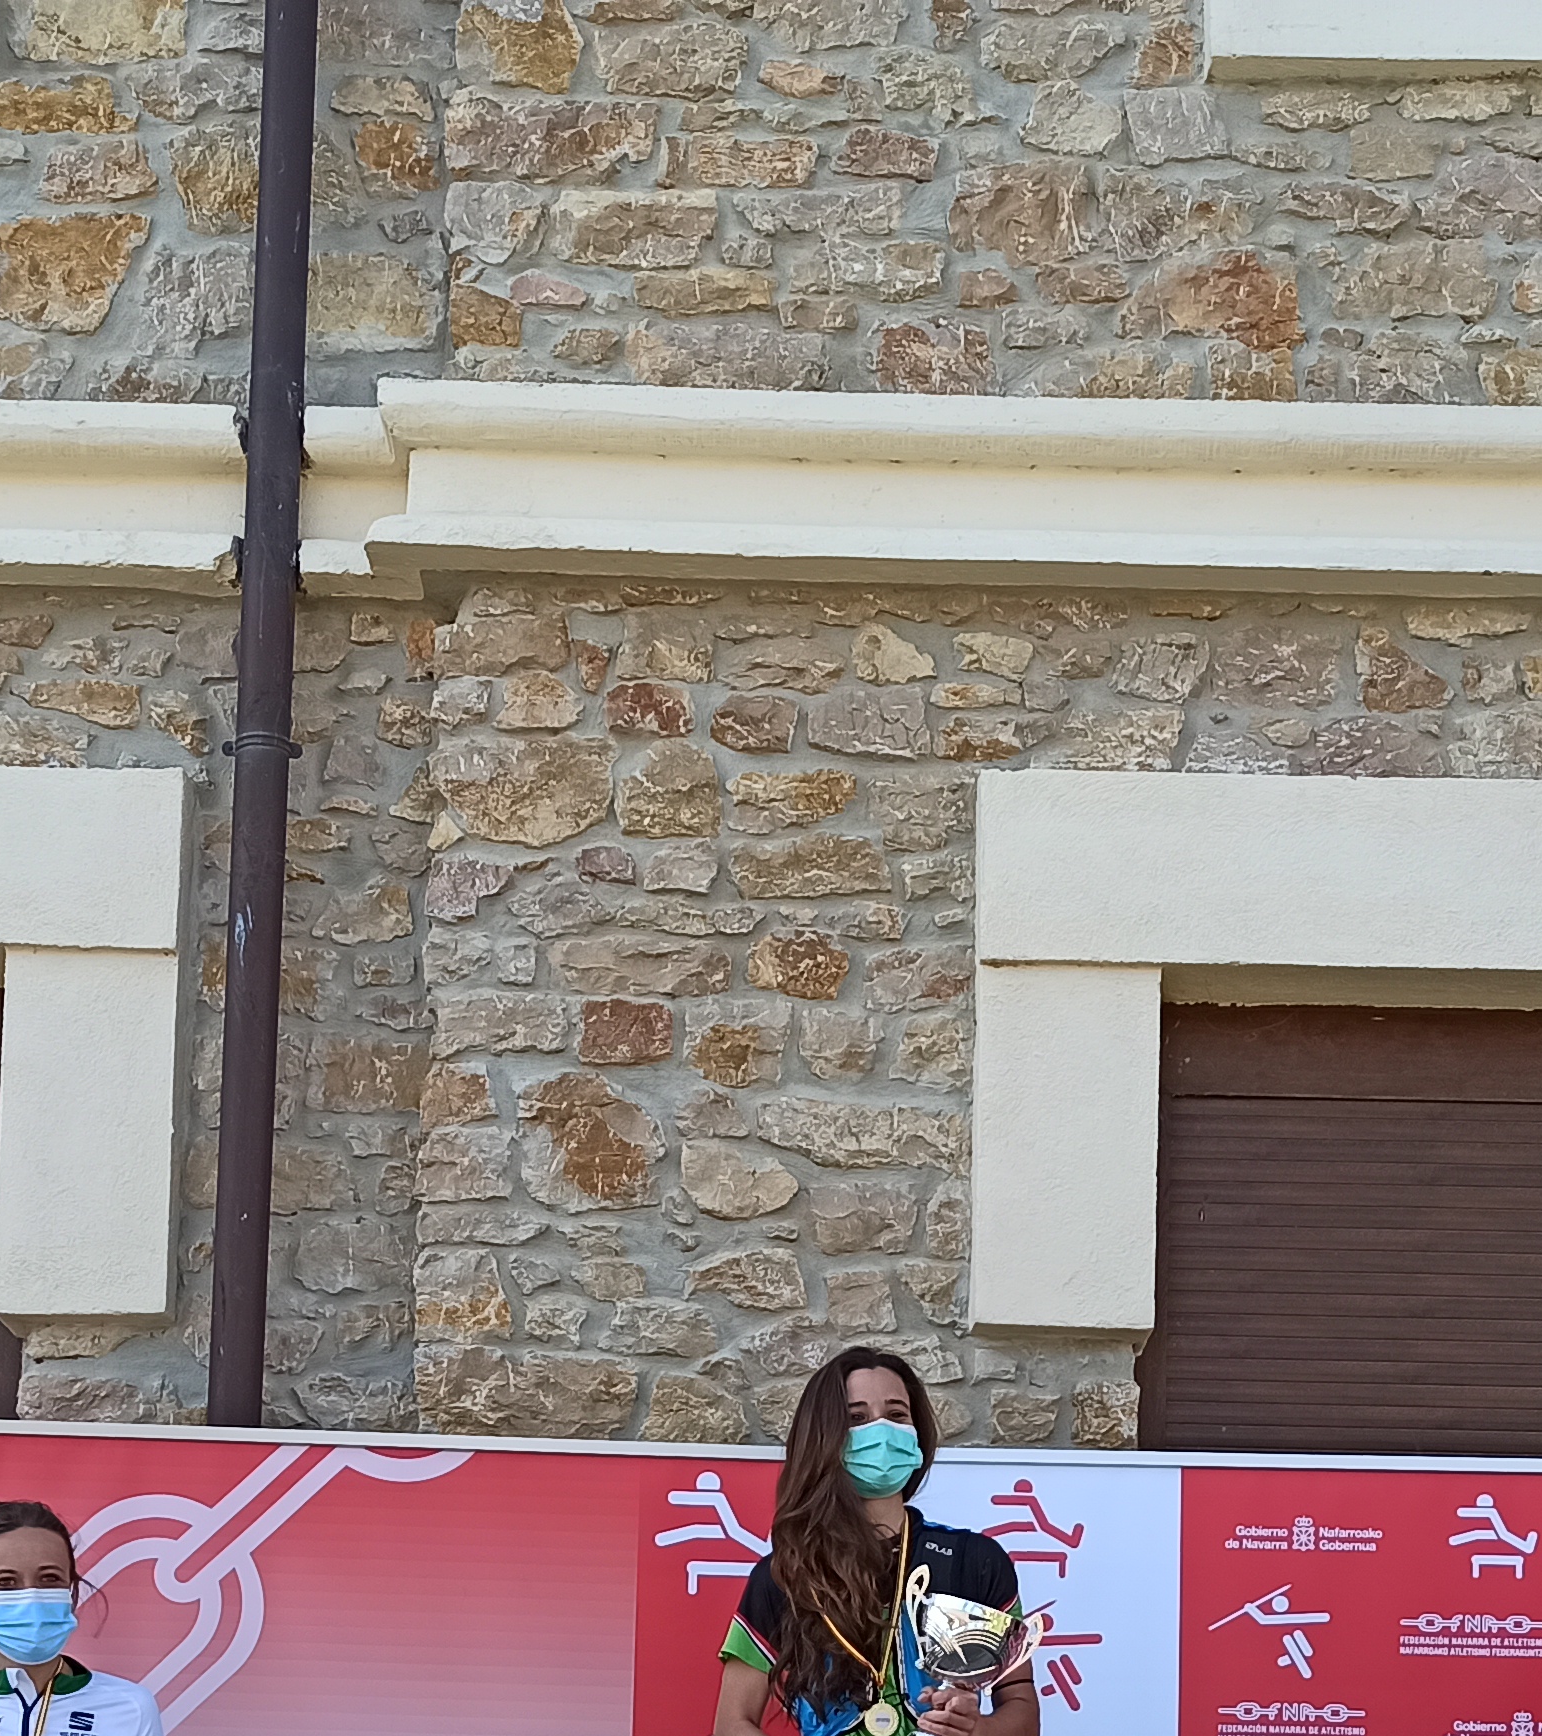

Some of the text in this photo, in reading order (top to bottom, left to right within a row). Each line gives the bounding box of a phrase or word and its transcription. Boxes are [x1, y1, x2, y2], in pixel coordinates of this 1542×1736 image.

[1236, 1526, 1288, 1536] Gobierno
[1319, 1527, 1382, 1538] Nafarroako
[1225, 1539, 1288, 1549] de Navarra
[1319, 1540, 1376, 1551] Gobernua
[1454, 1721, 1507, 1731] Gobierno
